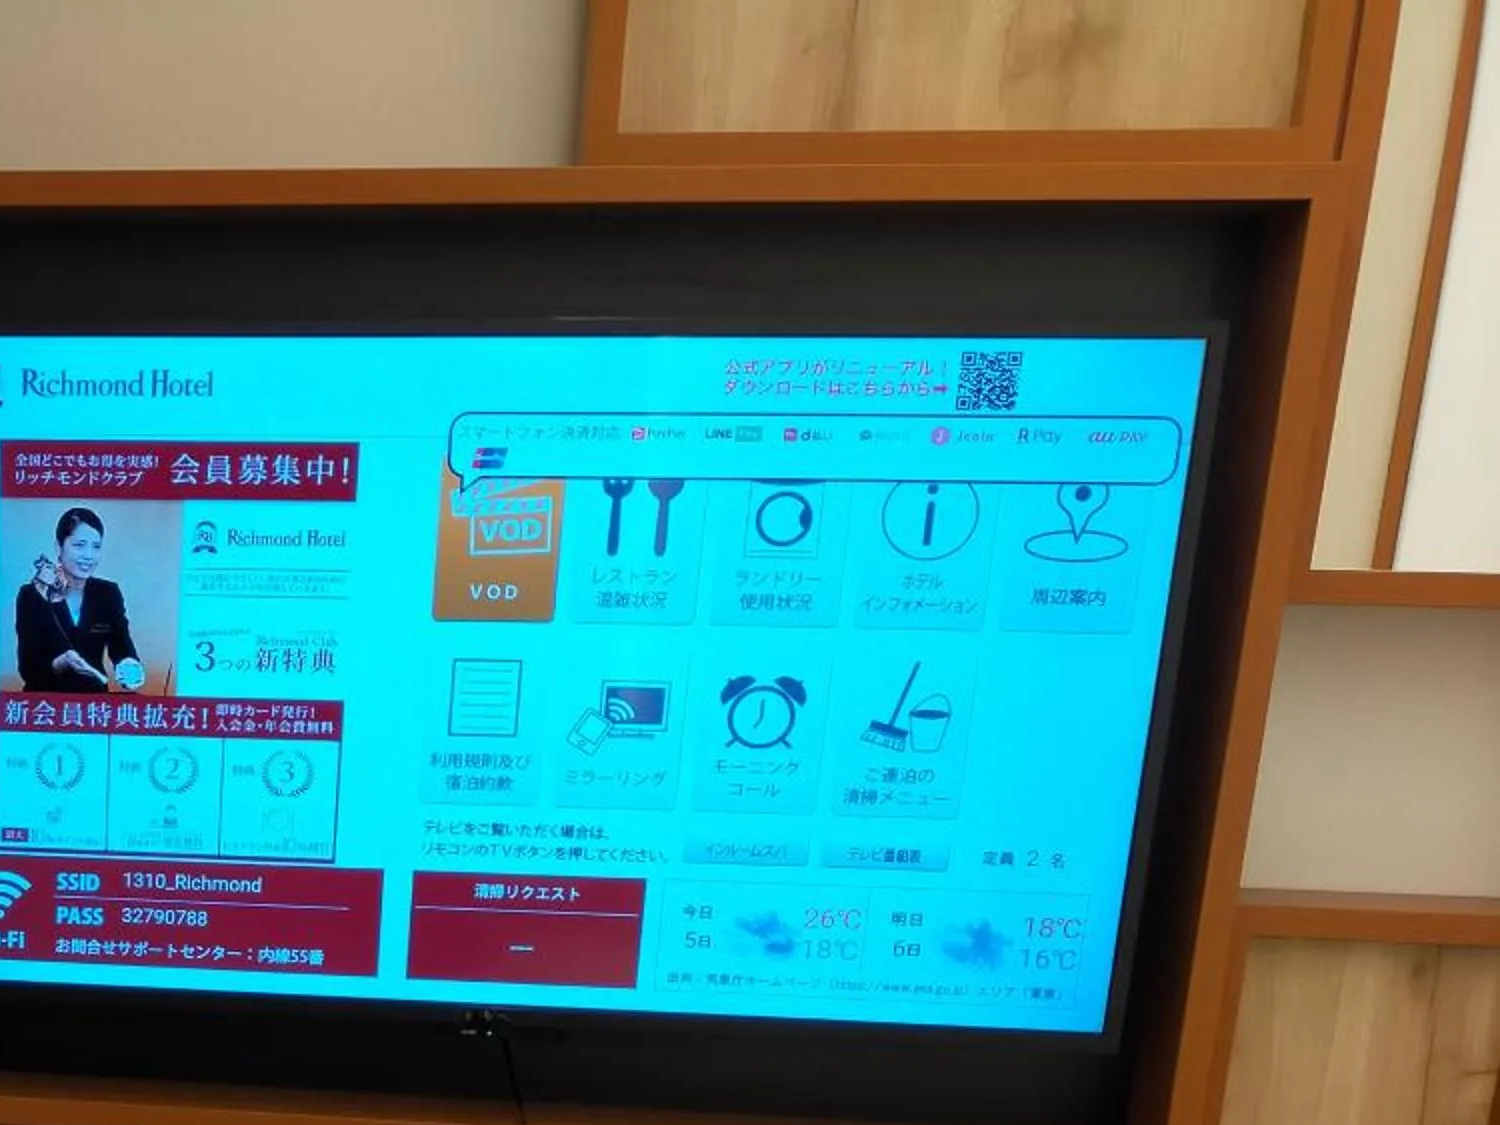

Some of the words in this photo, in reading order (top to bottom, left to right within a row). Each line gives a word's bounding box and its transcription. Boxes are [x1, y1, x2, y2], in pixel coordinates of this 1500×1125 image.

[21, 368, 145, 399] Richmond
[150, 369, 214, 398] Hotel
[705, 428, 733, 440] LINE
[14, 469, 144, 487] リッチモンドクラブ
[227, 528, 302, 548] Richmond
[306, 529, 347, 548] Hotel
[480, 518, 542, 543] VOD
[592, 568, 678, 586] レストラン
[735, 570, 821, 588] ランドリー
[901, 572, 944, 590] ホテル
[469, 584, 519, 601] VOD
[740, 594, 813, 612] 使用状況
[862, 594, 978, 614] インフォメーション
[164, 757, 181, 780] 2
[430, 752, 531, 771] 利用規則及び
[715, 759, 801, 777] モーニング
[280, 760, 296, 783] 3
[566, 770, 668, 788] ミラーリング
[864, 767, 935, 784] ご連泊の
[728, 782, 781, 799] コール
[843, 788, 951, 806] 清掃メニュー
[55, 872, 101, 893] SSID
[122, 872, 263, 894] 1310_Richmond
[474, 883, 581, 901] 清掃リクエスト
[55, 906, 104, 926] PASS
[121, 907, 209, 928] 32790788
[683, 904, 714, 920] 今日
[891, 911, 924, 927] 明日
[684, 931, 713, 949] 5日
[893, 942, 922, 958] 6日
